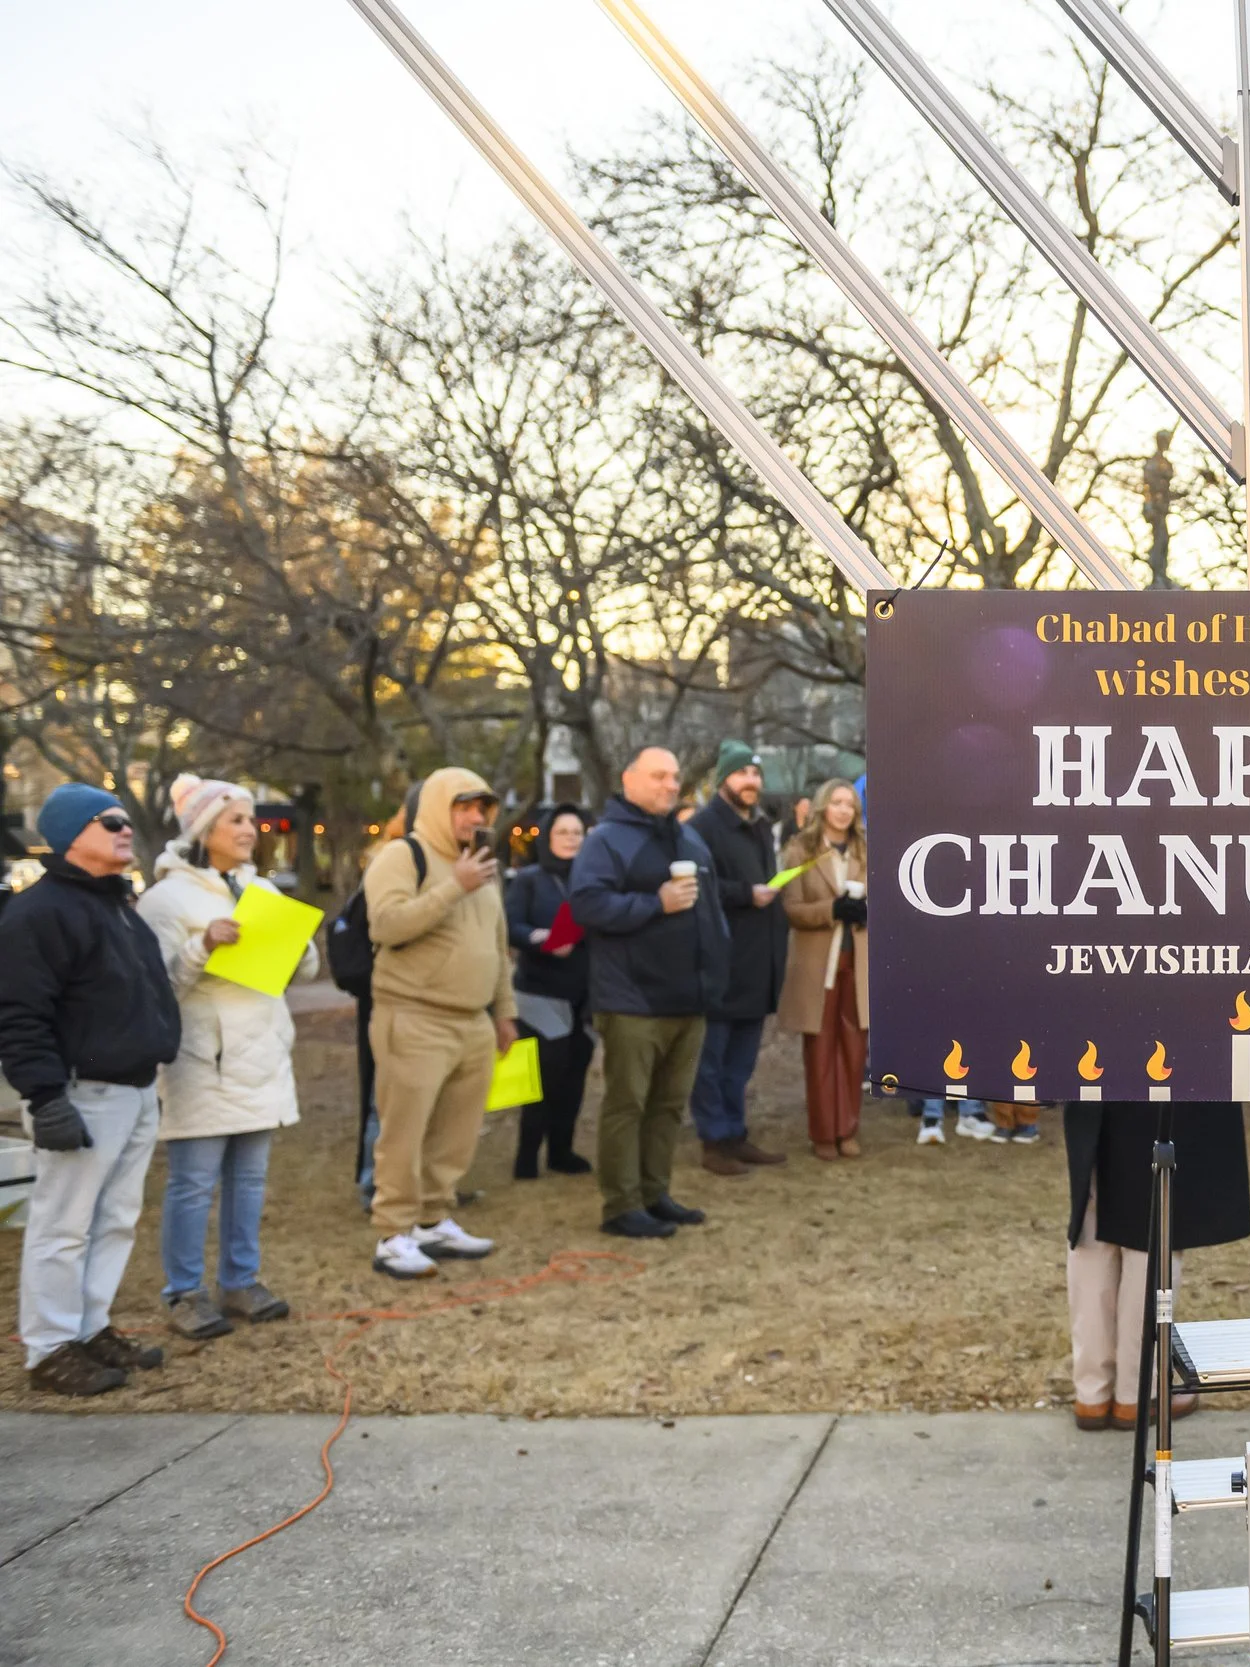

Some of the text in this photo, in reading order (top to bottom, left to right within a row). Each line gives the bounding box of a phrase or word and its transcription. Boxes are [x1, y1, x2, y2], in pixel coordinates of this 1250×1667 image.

[1036, 613, 1176, 644] Chabad
[1187, 613, 1228, 643] of
[1096, 659, 1250, 697] wishes
